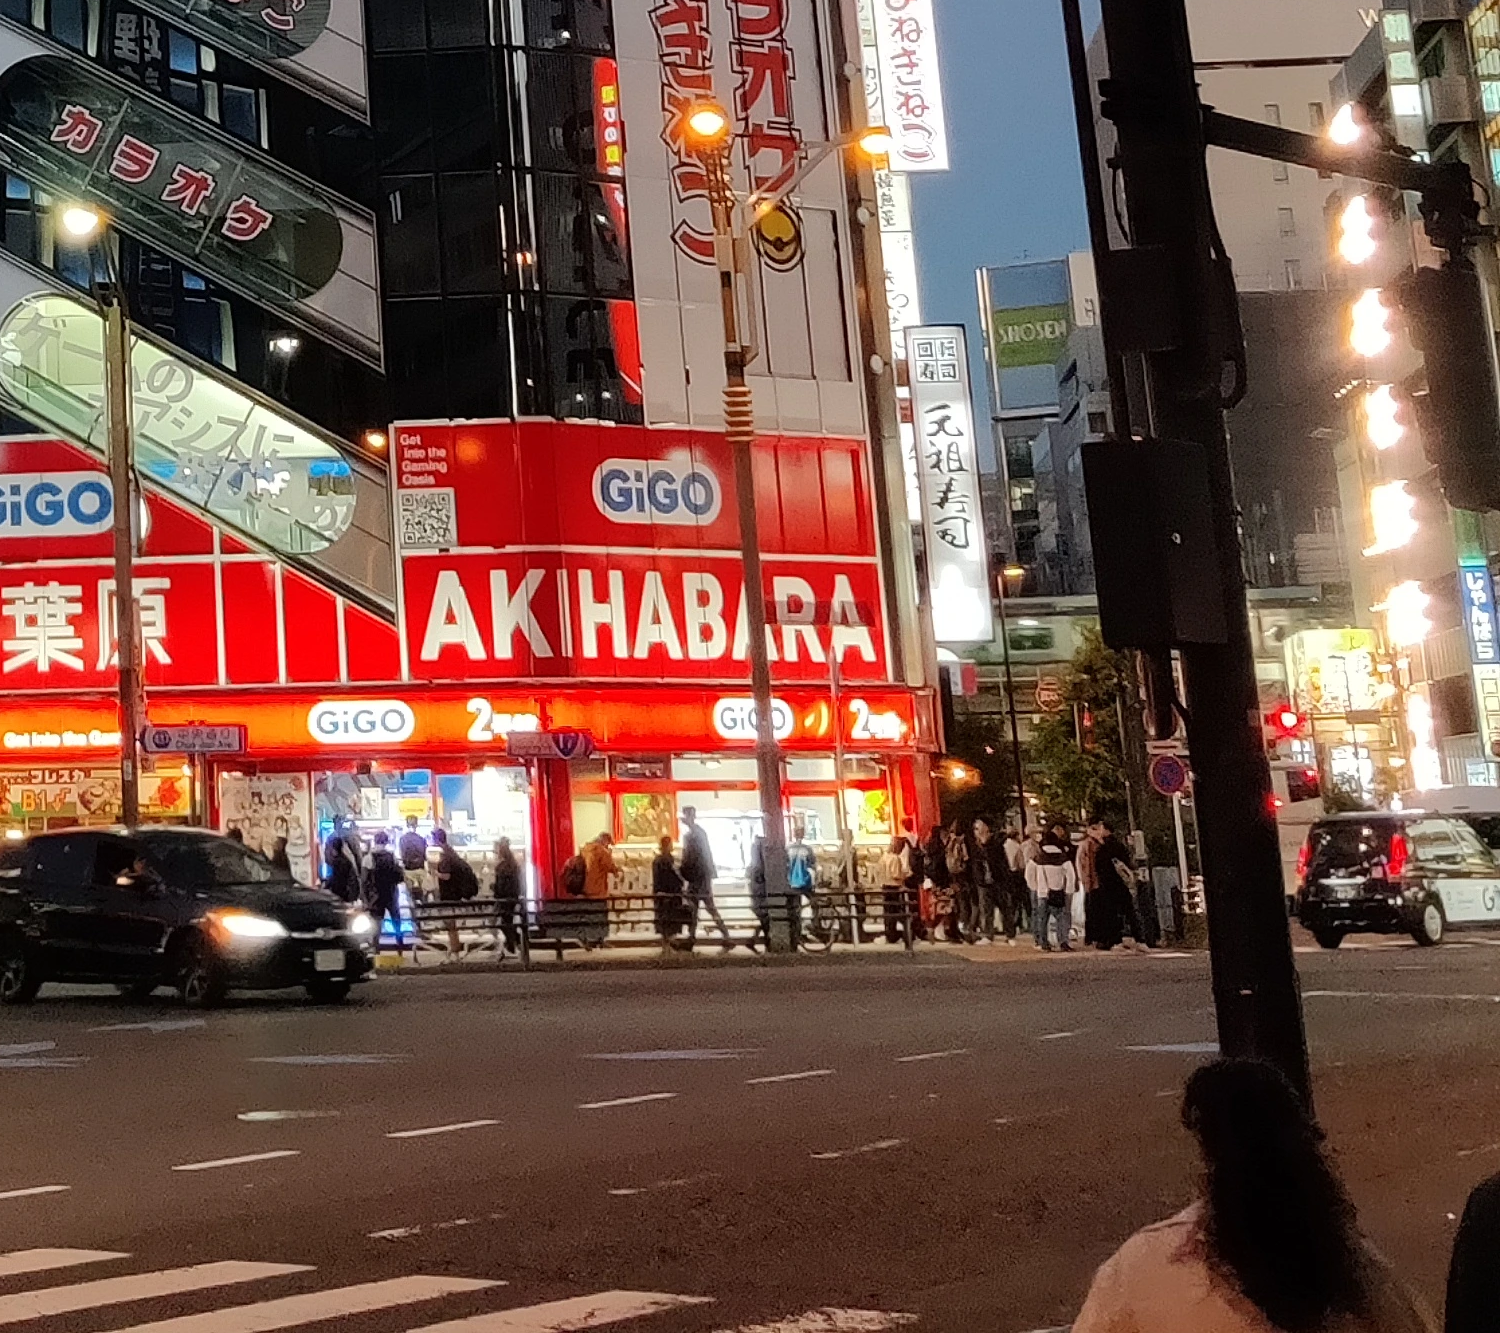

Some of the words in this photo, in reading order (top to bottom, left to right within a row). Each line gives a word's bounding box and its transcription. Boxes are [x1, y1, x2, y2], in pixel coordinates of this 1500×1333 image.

[50, 104, 274, 244] カラオケ
[998, 320, 1067, 344] SHOSEN
[14, 309, 196, 405] ゲーの
[400, 434, 422, 446] Get
[404, 447, 426, 459] Into
[428, 446, 447, 459] the
[402, 460, 448, 475] Gaming
[402, 473, 436, 487] Oasis
[924, 403, 970, 550] 元祖寿司
[600, 467, 714, 515] GiGO
[419, 566, 878, 663] AKIHABARA
[316, 708, 406, 735] GiGO
[20, 788, 49, 812] B1
